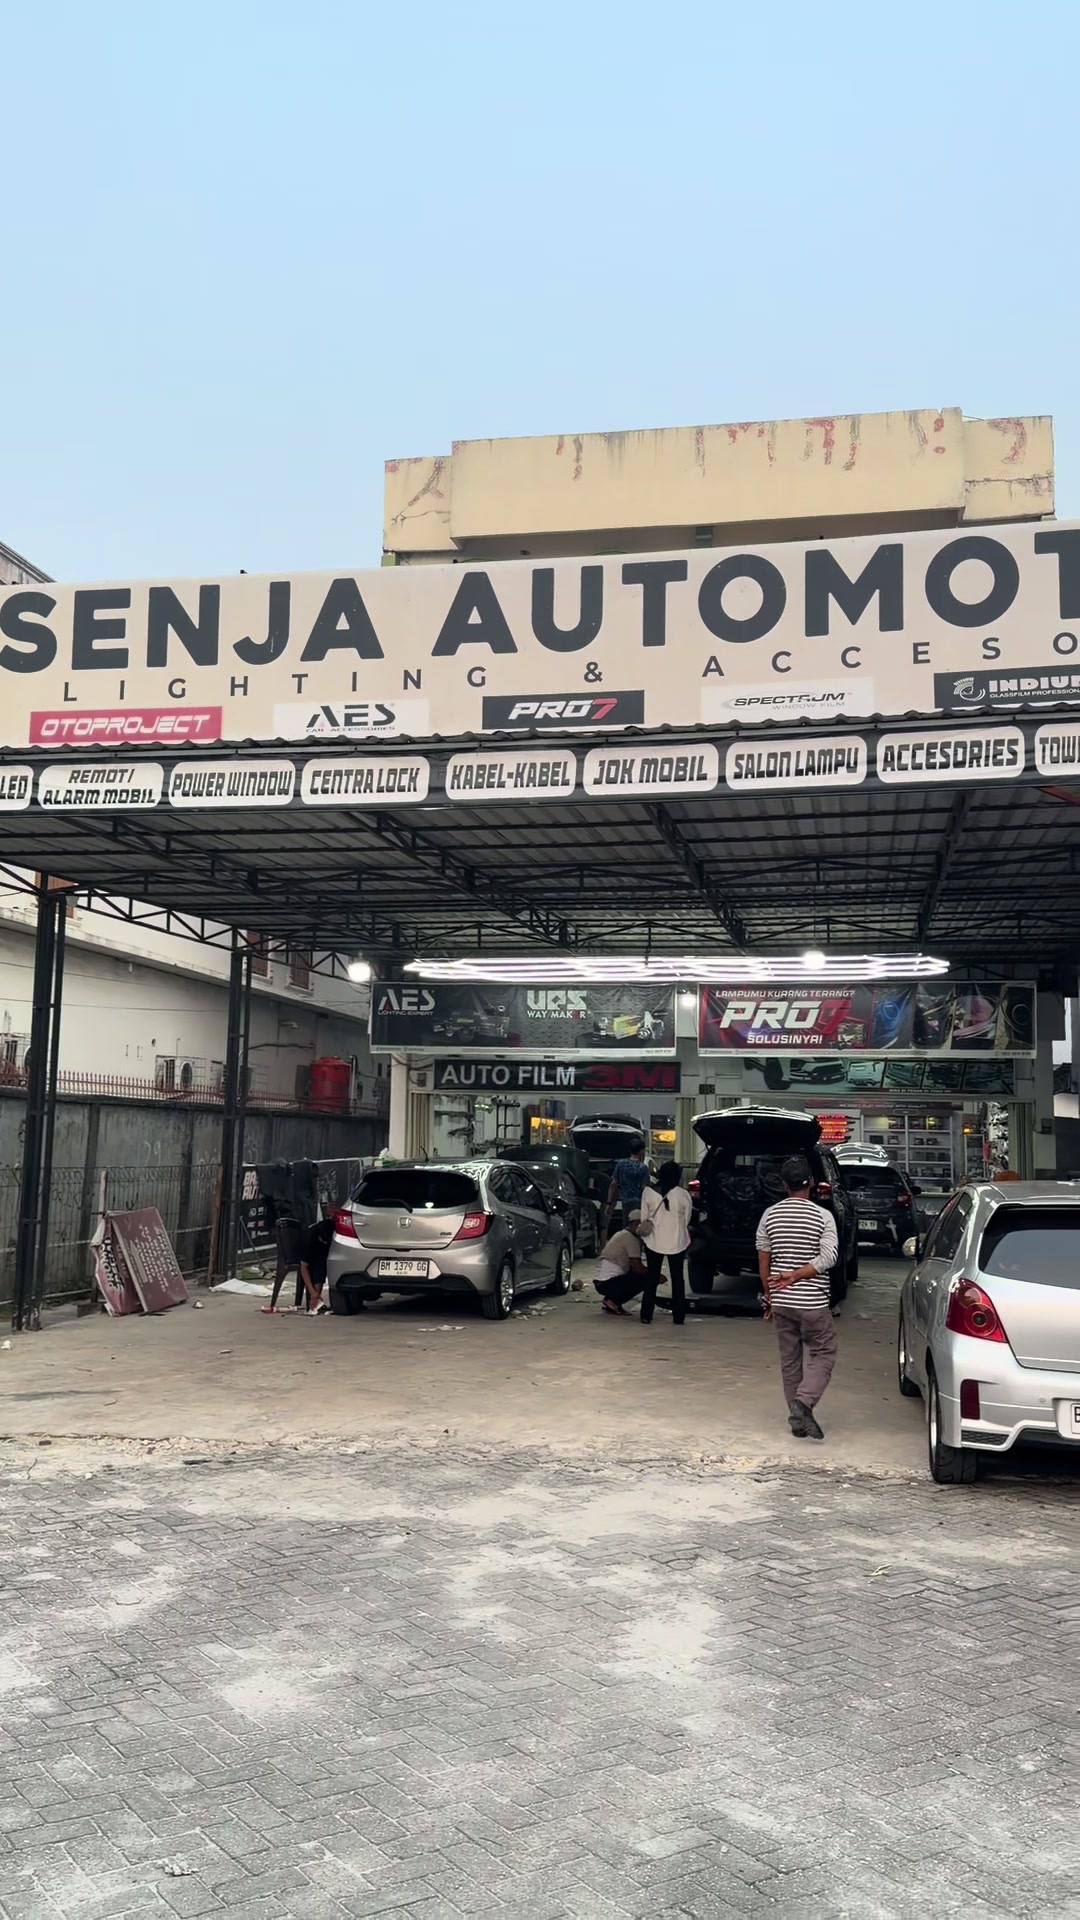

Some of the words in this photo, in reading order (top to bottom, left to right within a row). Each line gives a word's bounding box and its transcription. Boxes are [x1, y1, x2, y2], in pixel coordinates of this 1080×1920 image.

[0, 578, 385, 674] SENJA
[64, 667, 487, 702] LIGHTING
[583, 661, 604, 684] &
[508, 698, 618, 720] PRO7
[734, 693, 845, 707] SPECTRUM
[40, 714, 211, 737] OTOPROJECT
[882, 739, 1019, 772] ACCESORIES
[1039, 735, 1080, 765] TOW
[592, 758, 636, 785] JOK
[638, 755, 708, 783] MOBIL
[733, 751, 792, 780] SALON
[793, 747, 859, 777] LAMPU
[171, 772, 225, 797] POWER
[226, 771, 293, 796] WINDOW
[450, 761, 571, 790] KABEL-KABEL
[43, 789, 100, 805] ALARM
[102, 788, 155, 804] MOBIL
[716, 990, 767, 998] LAMPUMU
[768, 990, 808, 998] KURANG
[809, 989, 855, 998] TERANG?
[527, 1010, 548, 1018] WAY
[747, 1034, 823, 1046] SOLUSINYA!
[441, 1065, 510, 1086] AUTO
[518, 1065, 576, 1086] FILM
[583, 1066, 676, 1088] 3M
[380, 1261, 391, 1271] BM
[394, 1262, 414, 1271] 1379
